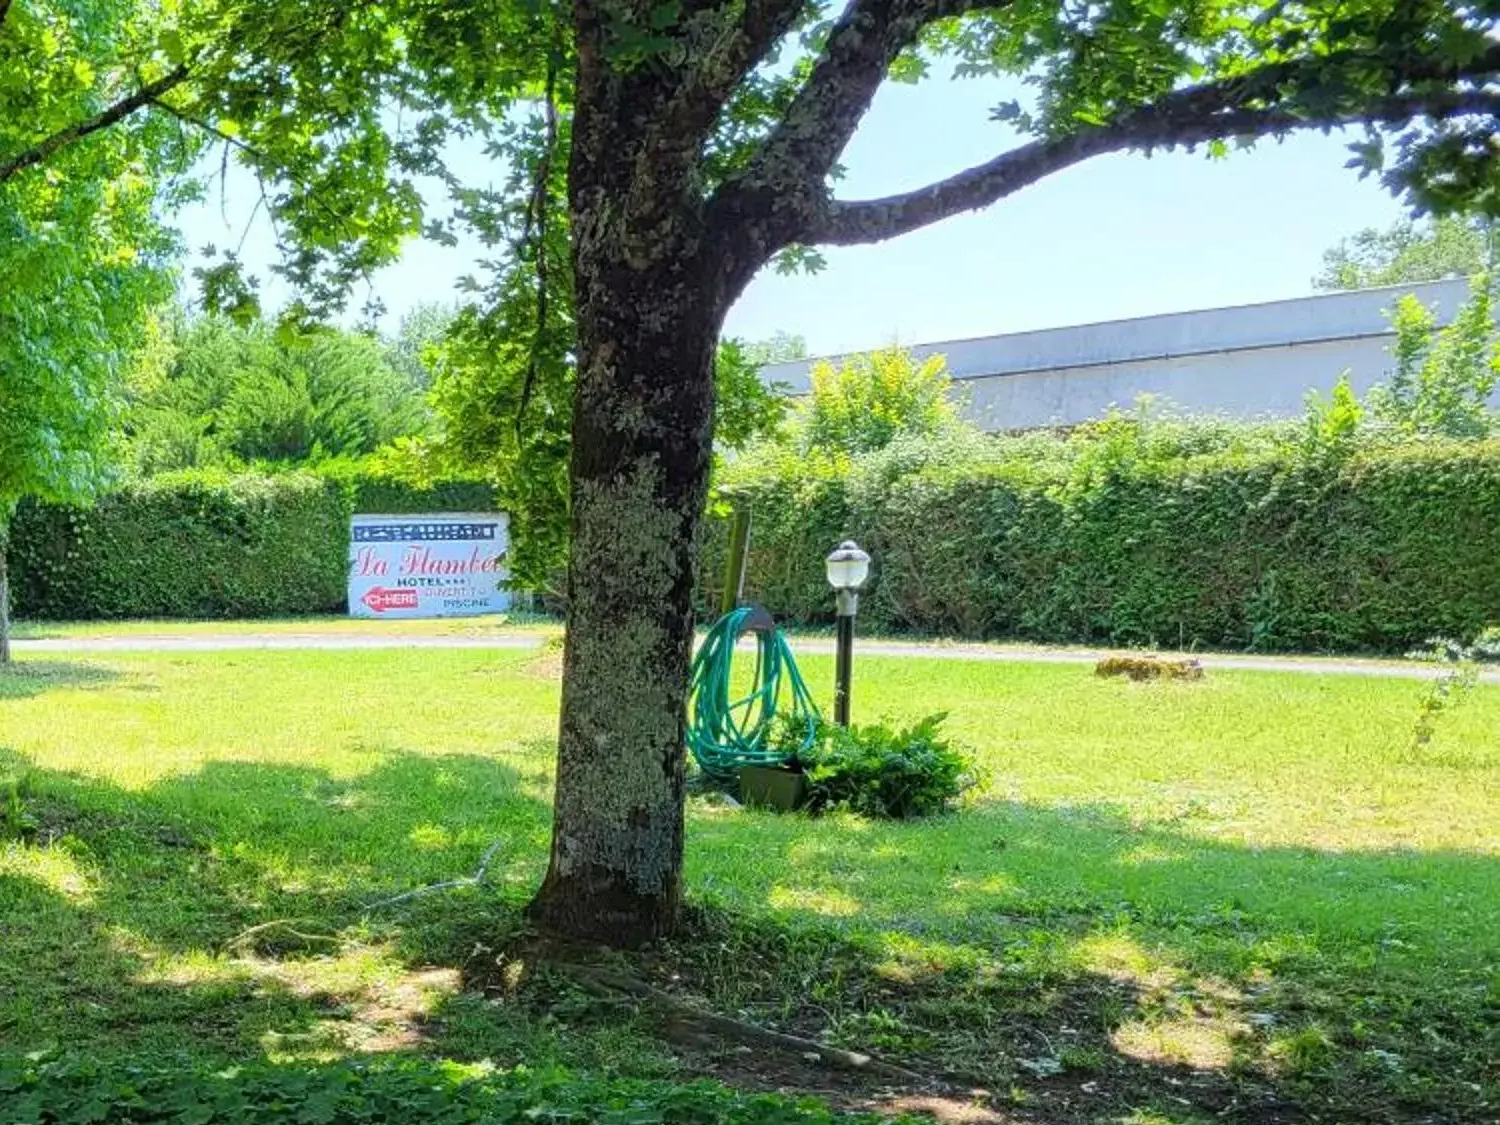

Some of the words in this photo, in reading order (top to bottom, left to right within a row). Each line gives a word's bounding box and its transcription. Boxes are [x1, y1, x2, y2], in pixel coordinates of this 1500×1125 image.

[357, 545, 389, 577] La
[397, 577, 445, 588] HOTEL
[443, 598, 491, 609] PISCINE
